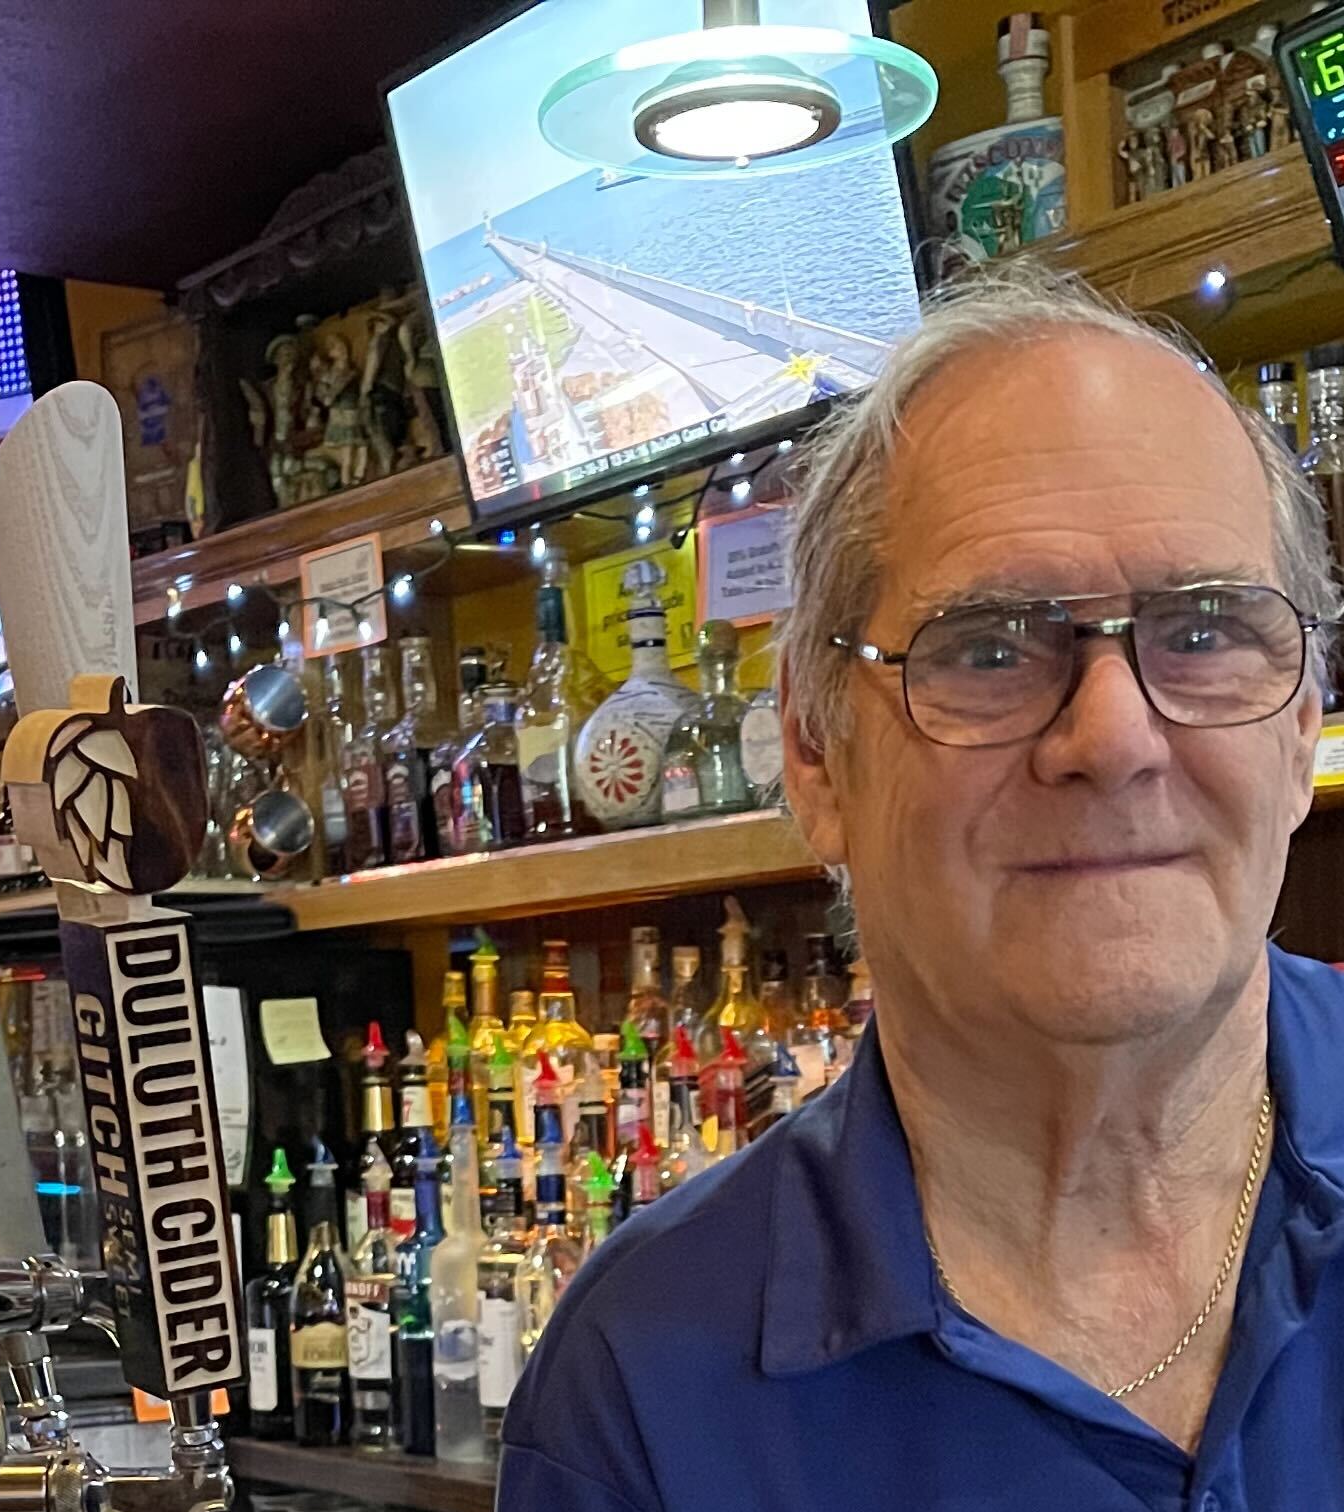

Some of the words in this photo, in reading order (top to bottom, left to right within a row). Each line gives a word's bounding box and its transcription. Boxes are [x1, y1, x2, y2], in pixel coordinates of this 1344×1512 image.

[74, 992, 132, 1198] GITCH
[114, 932, 211, 1191] DULUTH
[151, 1196, 234, 1382] CIDER
